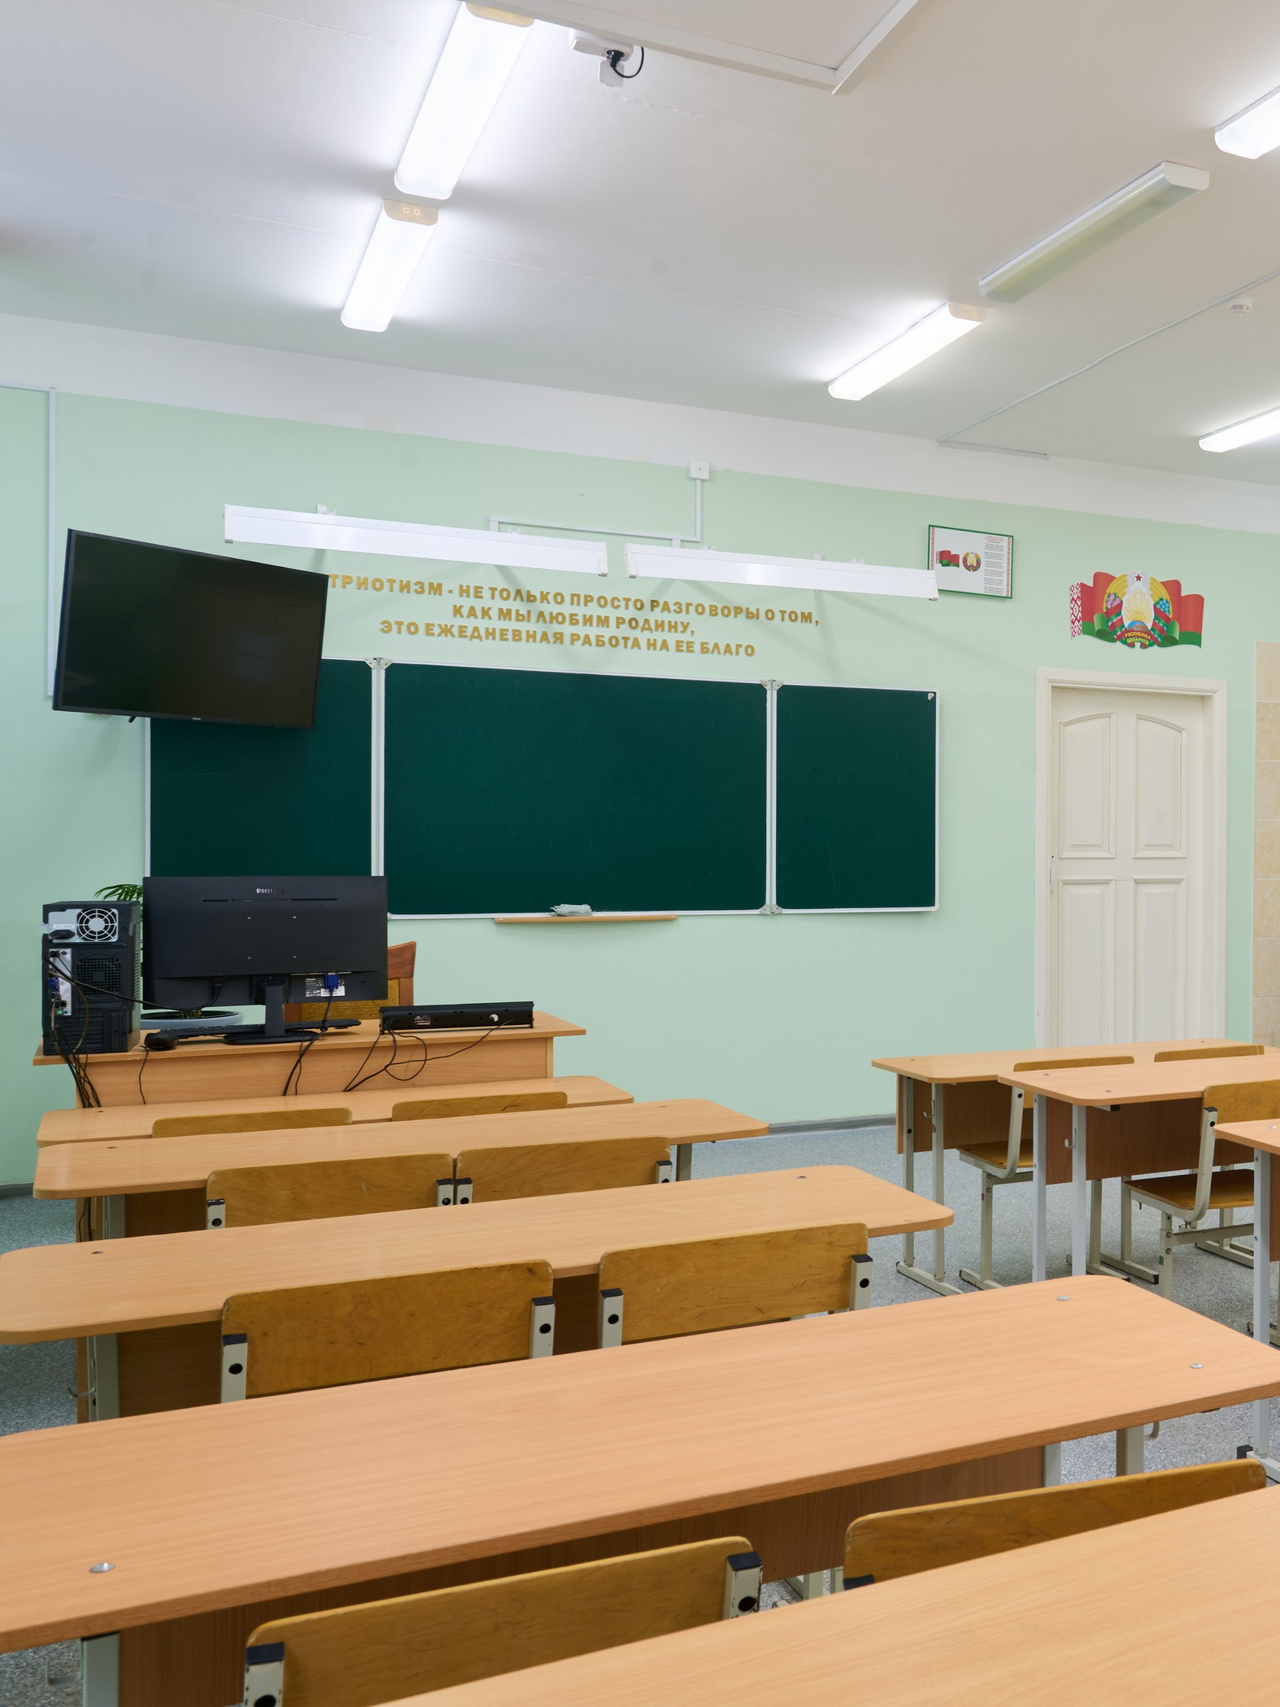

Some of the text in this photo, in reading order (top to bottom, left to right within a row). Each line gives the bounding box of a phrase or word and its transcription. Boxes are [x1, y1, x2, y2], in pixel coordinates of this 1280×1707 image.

[329, 574, 443, 596] ТРИОТИЗМ
[459, 584, 484, 599] НЕ
[489, 586, 565, 605] ТОЛЬКО
[570, 592, 645, 611] ПРОСТО
[650, 599, 760, 621] РАЗГОВОРЫ
[765, 609, 775, 621] О
[779, 609, 819, 626] ТОМ,
[380, 620, 755, 657] ЭТО ЕЖЕДНЕВНАЯ РАБОТА НА ЕЕ БЛАГО
[453, 604, 695, 637] КАК МЫ ЛЮБИМ РОДИНУ,
